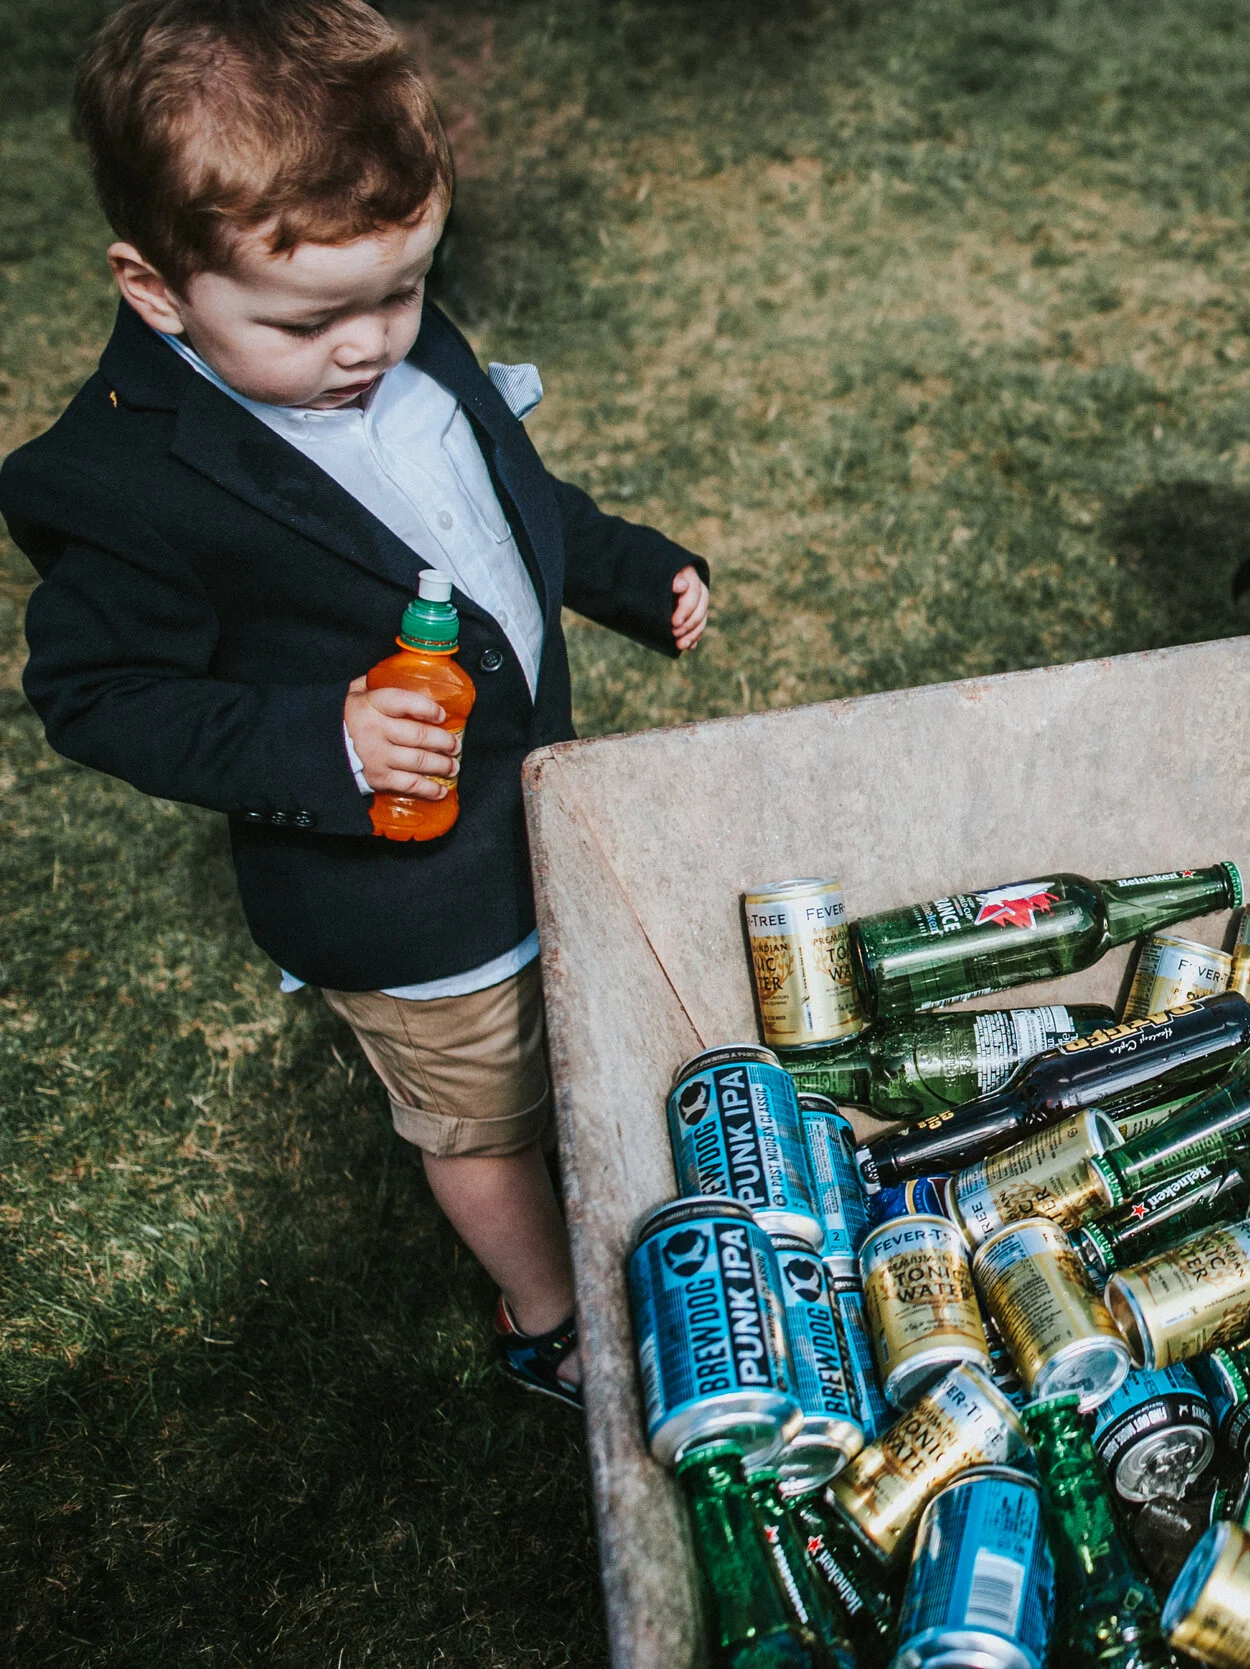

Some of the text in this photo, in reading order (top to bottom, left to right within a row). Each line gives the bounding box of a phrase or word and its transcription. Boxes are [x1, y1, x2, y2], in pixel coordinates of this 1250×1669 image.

[1117, 872, 1179, 888] Heineken
[748, 913, 787, 927] -TREE
[933, 897, 961, 933] RANCE
[1178, 959, 1228, 984] FVER-T
[756, 1087, 773, 1124] CLASSIC
[694, 1122, 728, 1198] EWDOG
[719, 1069, 765, 1208] IPA PUNK
[1146, 1165, 1211, 1209] Heineken
[971, 1201, 994, 1235] REE
[719, 1227, 769, 1385] IPA PUNK
[686, 1277, 730, 1395] BREWDOG
[807, 1307, 849, 1416] BREWDOG
[817, 1548, 864, 1616] Heineken
